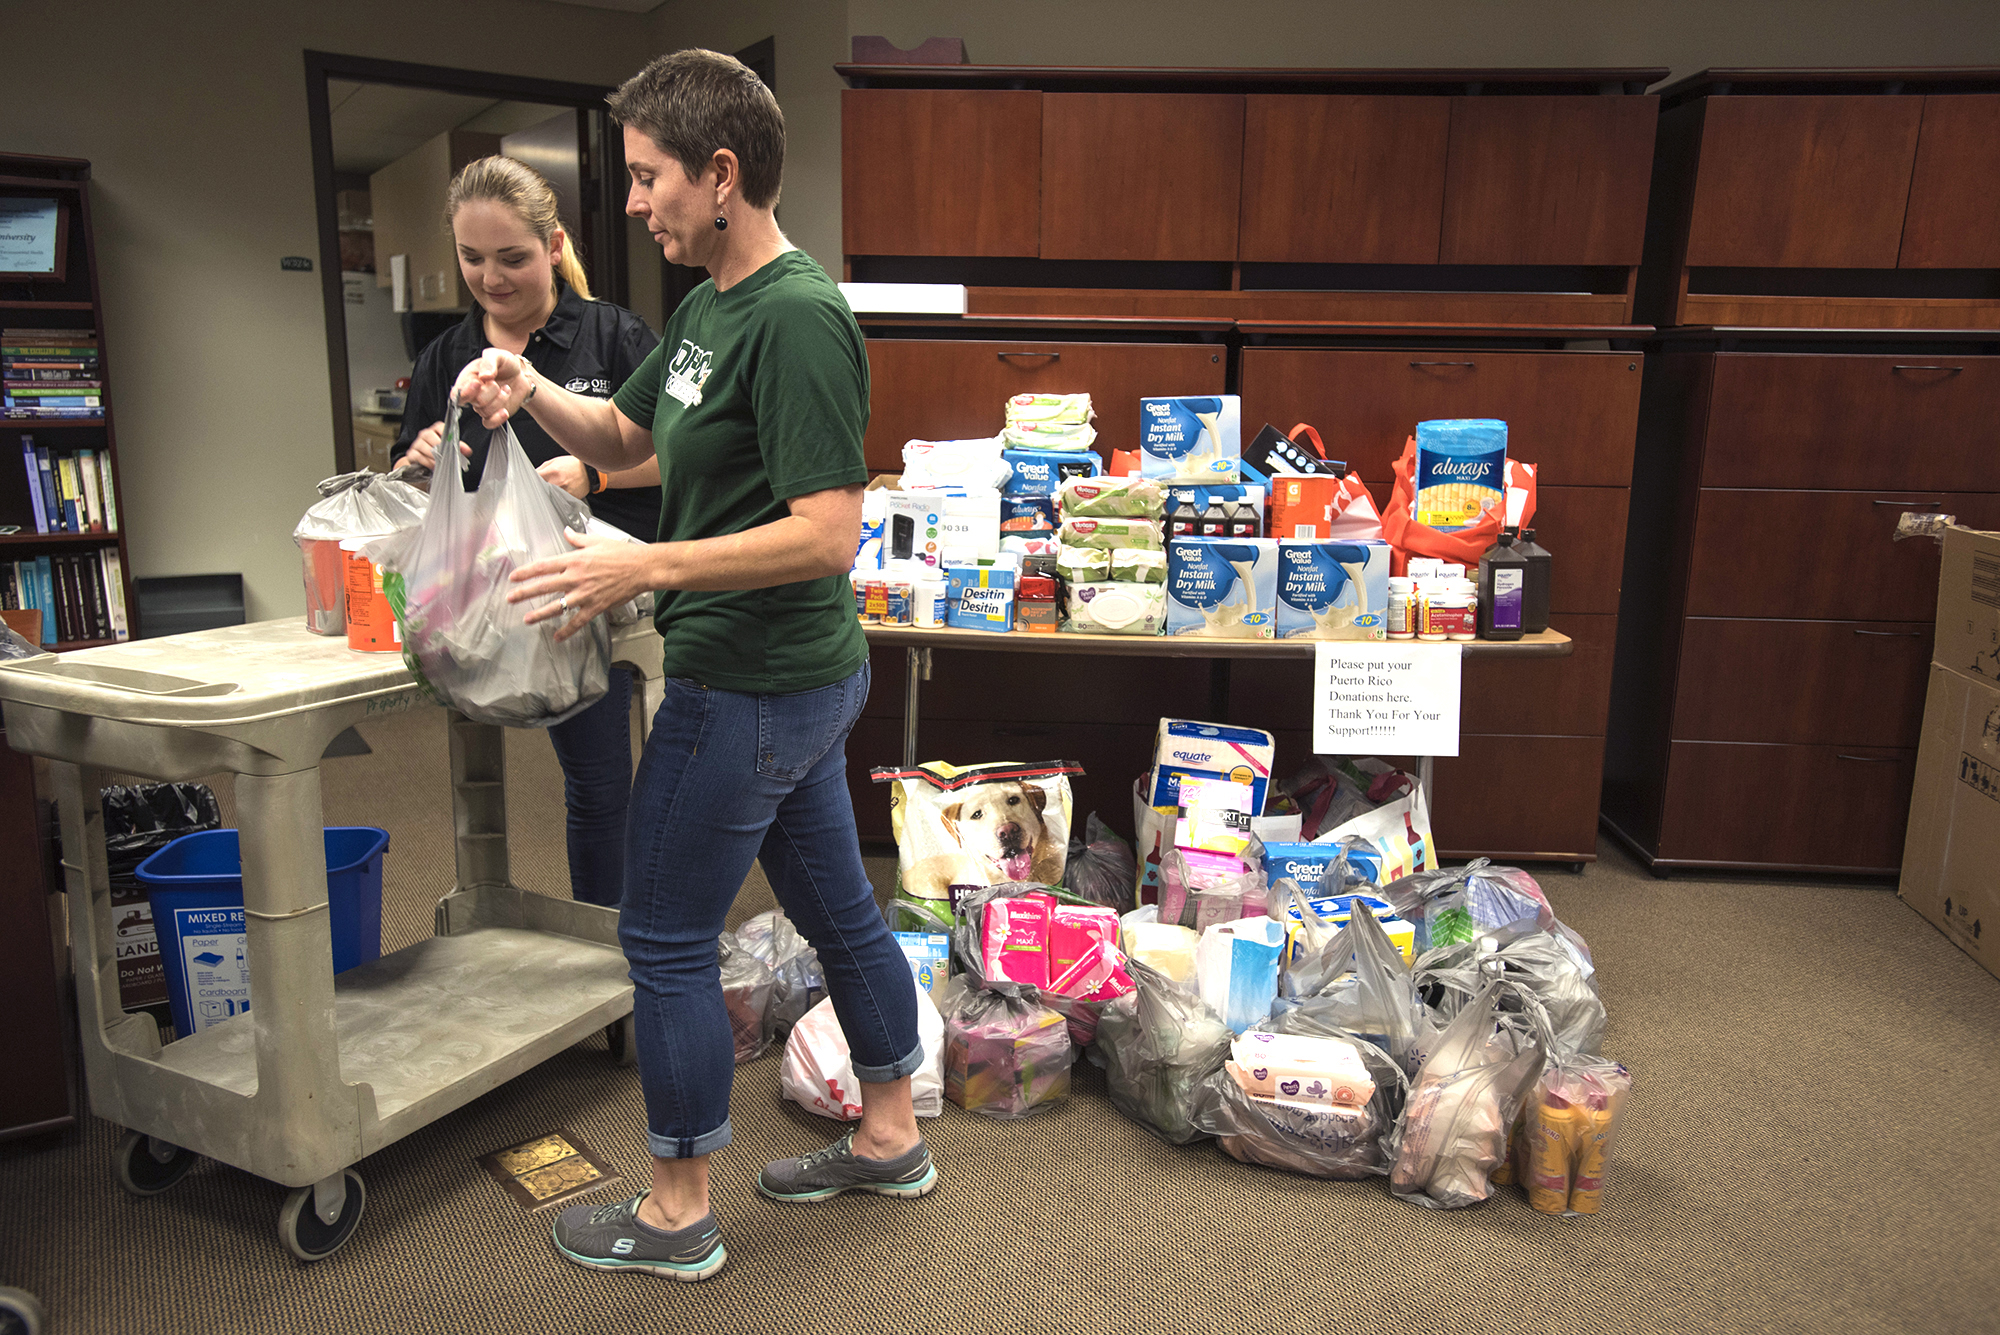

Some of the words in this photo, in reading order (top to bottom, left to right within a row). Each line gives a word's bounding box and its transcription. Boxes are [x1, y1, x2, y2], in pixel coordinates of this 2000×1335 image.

[1146, 403, 1171, 412] Great
[1150, 424, 1182, 432] Instant
[1147, 434, 1164, 443] Dry
[1165, 432, 1185, 441] Milk
[1017, 461, 1050, 474] Great
[1217, 461, 1227, 470] 10
[1432, 457, 1491, 480] always
[1024, 472, 1049, 480] Value
[1022, 484, 1047, 492] Nonfat
[1289, 484, 1299, 495] G
[890, 501, 911, 509] Pocket
[1011, 505, 1039, 515] always
[1175, 546, 1202, 556] Great
[1285, 549, 1312, 559] Great
[1187, 563, 1208, 571] Nonfat
[1297, 565, 1319, 573] Nonfat
[1179, 569, 1214, 580] Instant
[1288, 571, 1324, 581] Instant
[1176, 579, 1193, 590] Dry
[1195, 580, 1216, 590] Milk
[1285, 582, 1304, 593] Dry
[1305, 582, 1327, 592] Milk
[964, 588, 1005, 599] Desitin
[961, 600, 999, 614] Desitin
[1249, 614, 1261, 623] 10
[1361, 616, 1372, 625] 10
[1330, 659, 1364, 669] Please
[1367, 661, 1384, 672] put
[1388, 662, 1412, 672] your
[1330, 675, 1364, 685] Puerto
[1368, 676, 1393, 686] Rico
[1329, 691, 1383, 702] Donations
[1387, 692, 1412, 702] here.
[1328, 709, 1361, 719] Thank
[1366, 709, 1388, 719] You
[1392, 710, 1410, 720] For
[1414, 710, 1441, 720] Your
[1328, 725, 1396, 737] Support!!!!!!
[1173, 751, 1211, 762] equate
[1285, 861, 1324, 874] Great
[1294, 873, 1321, 882] Value
[188, 912, 227, 923] MIXED
[1010, 911, 1042, 920] Maxithins
[193, 938, 219, 947] Paper
[120, 969, 135, 978] Do
[137, 964, 155, 975] Not
[920, 973, 931, 984] 10
[199, 988, 247, 997] Cardboard
[1541, 1124, 1561, 1142] BOND
[611, 1238, 636, 1255] S
